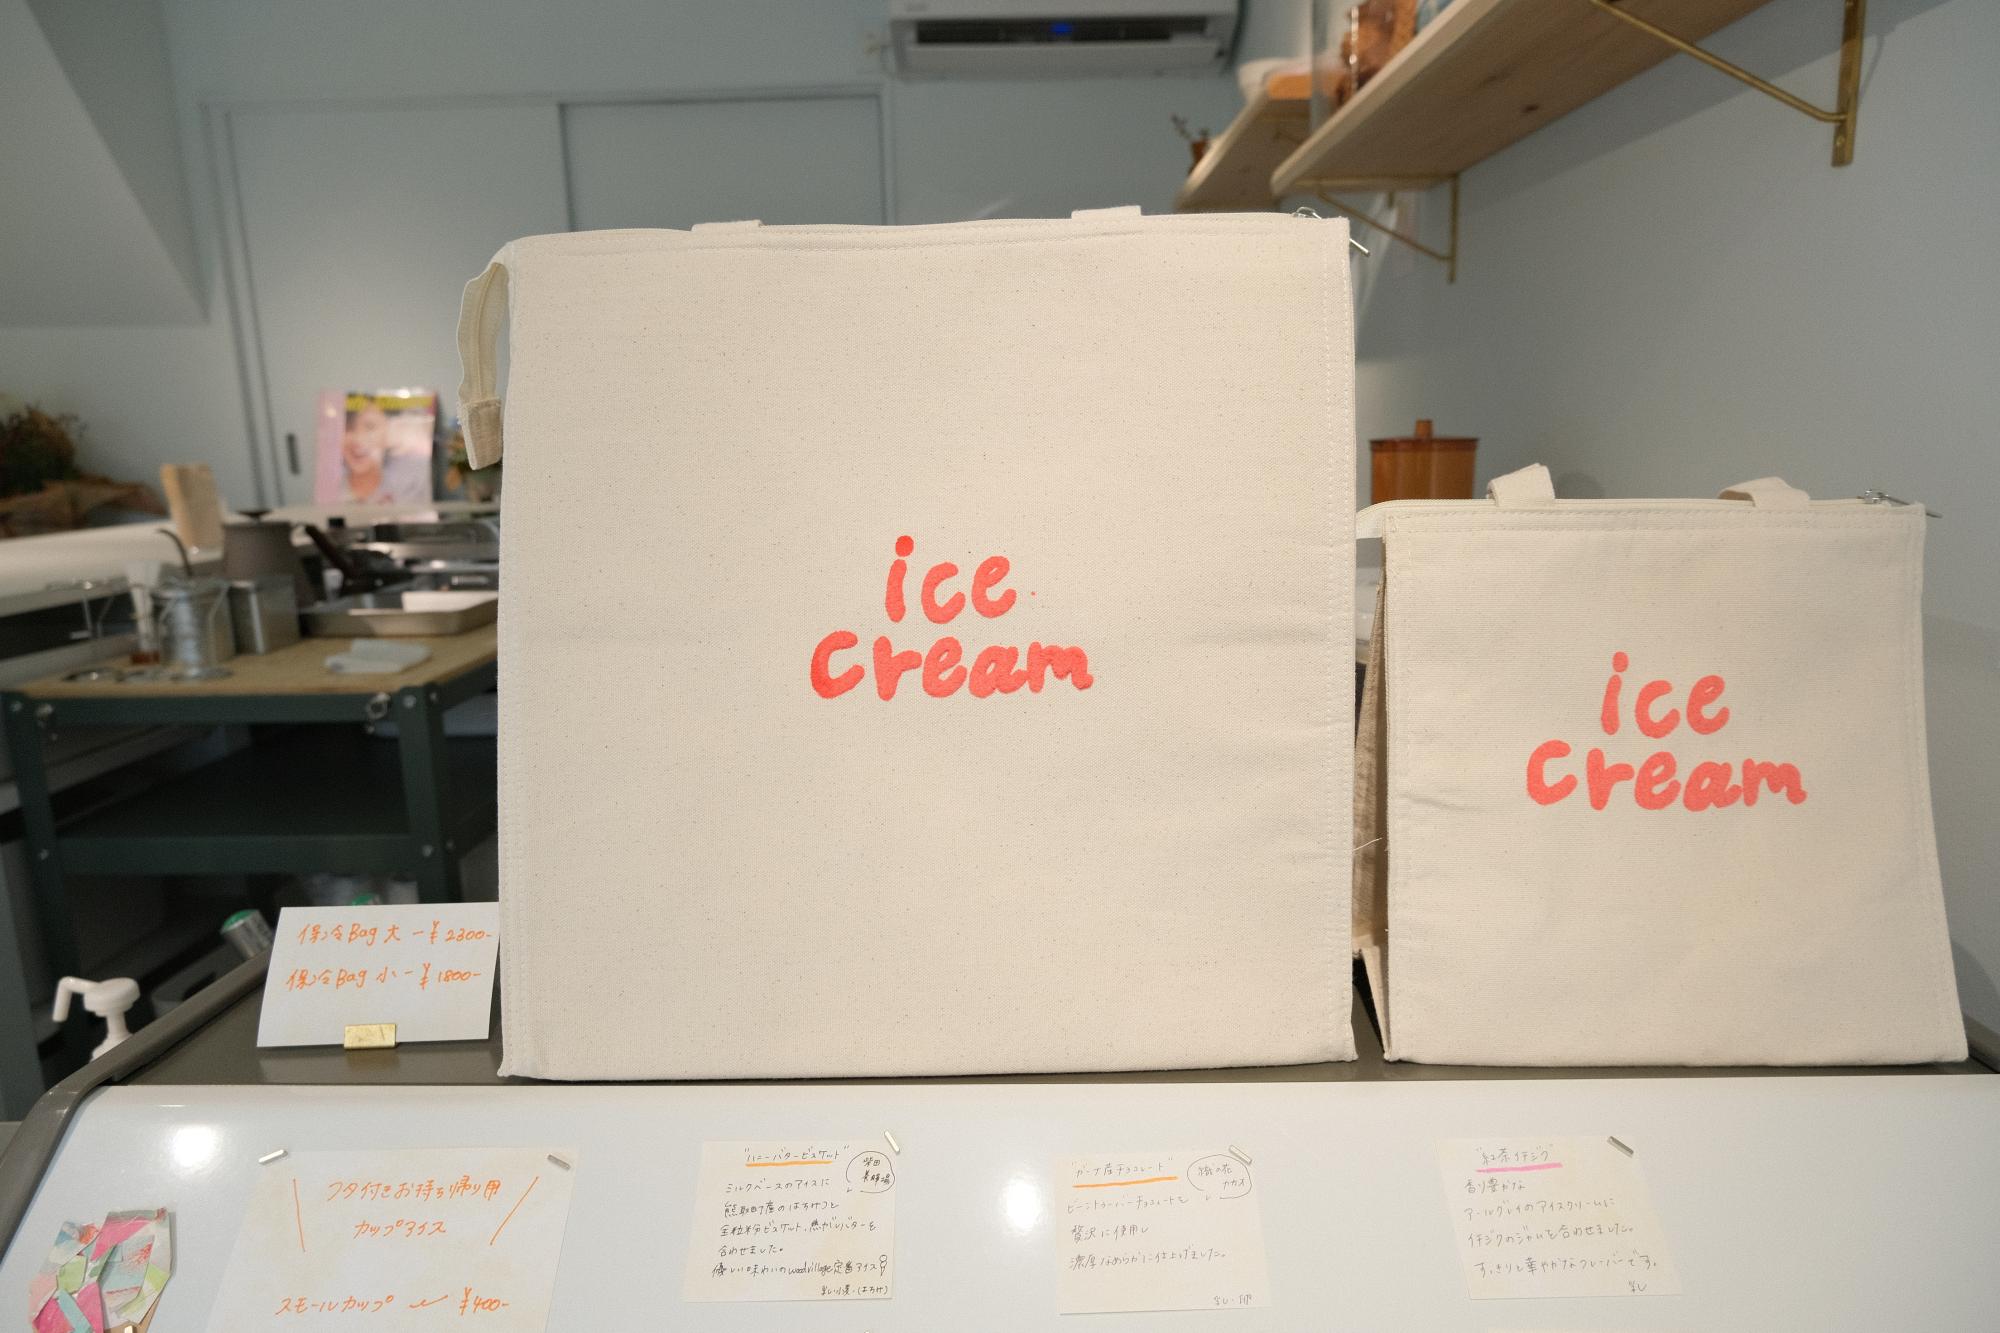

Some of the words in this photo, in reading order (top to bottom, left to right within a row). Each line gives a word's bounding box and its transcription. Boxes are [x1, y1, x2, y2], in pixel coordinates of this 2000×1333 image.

[885, 535, 1017, 624] ice
[810, 630, 1094, 701] cream
[1601, 651, 1730, 739] ice
[1526, 739, 1808, 812] cream
[326, 1174, 502, 1202] フタ付きお持ち帰り用
[353, 1219, 447, 1240] カップアイス
[275, 1295, 395, 1316] スモールカップ
